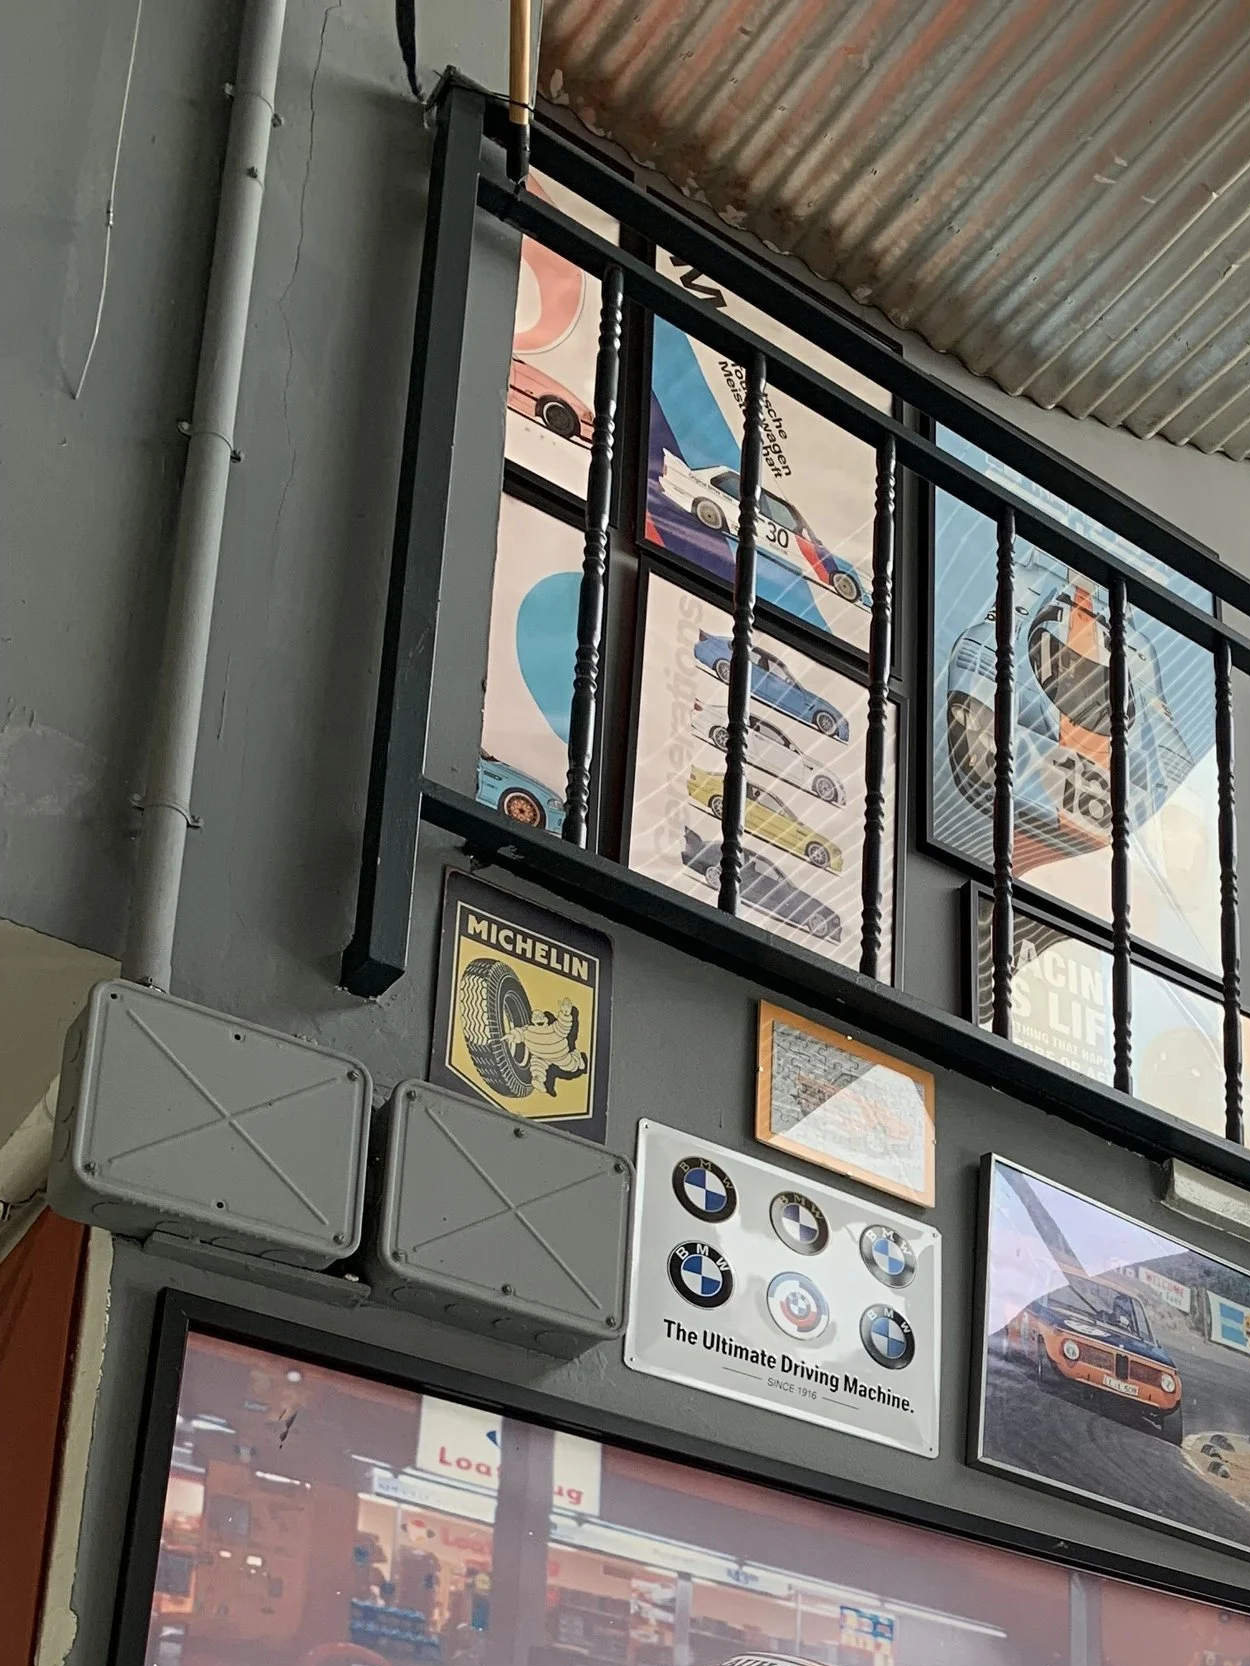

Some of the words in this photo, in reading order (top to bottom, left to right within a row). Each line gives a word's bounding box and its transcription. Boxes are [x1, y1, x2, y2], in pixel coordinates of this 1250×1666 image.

[766, 521, 789, 549] 30
[467, 914, 589, 981] MICHELIN
[1015, 938, 1105, 1004] ACIN
[1050, 992, 1105, 1047] LIF
[1052, 1034, 1079, 1056] THAT
[675, 1244, 730, 1271] BMW
[866, 1308, 912, 1334] BMW
[664, 1319, 698, 1346] The
[703, 1330, 776, 1369] Ultimate
[781, 1355, 840, 1393] Driving
[844, 1374, 915, 1413] Machine.
[767, 1378, 795, 1394] SINCE
[798, 1387, 817, 1400] 1916
[438, 1446, 500, 1477] Loa
